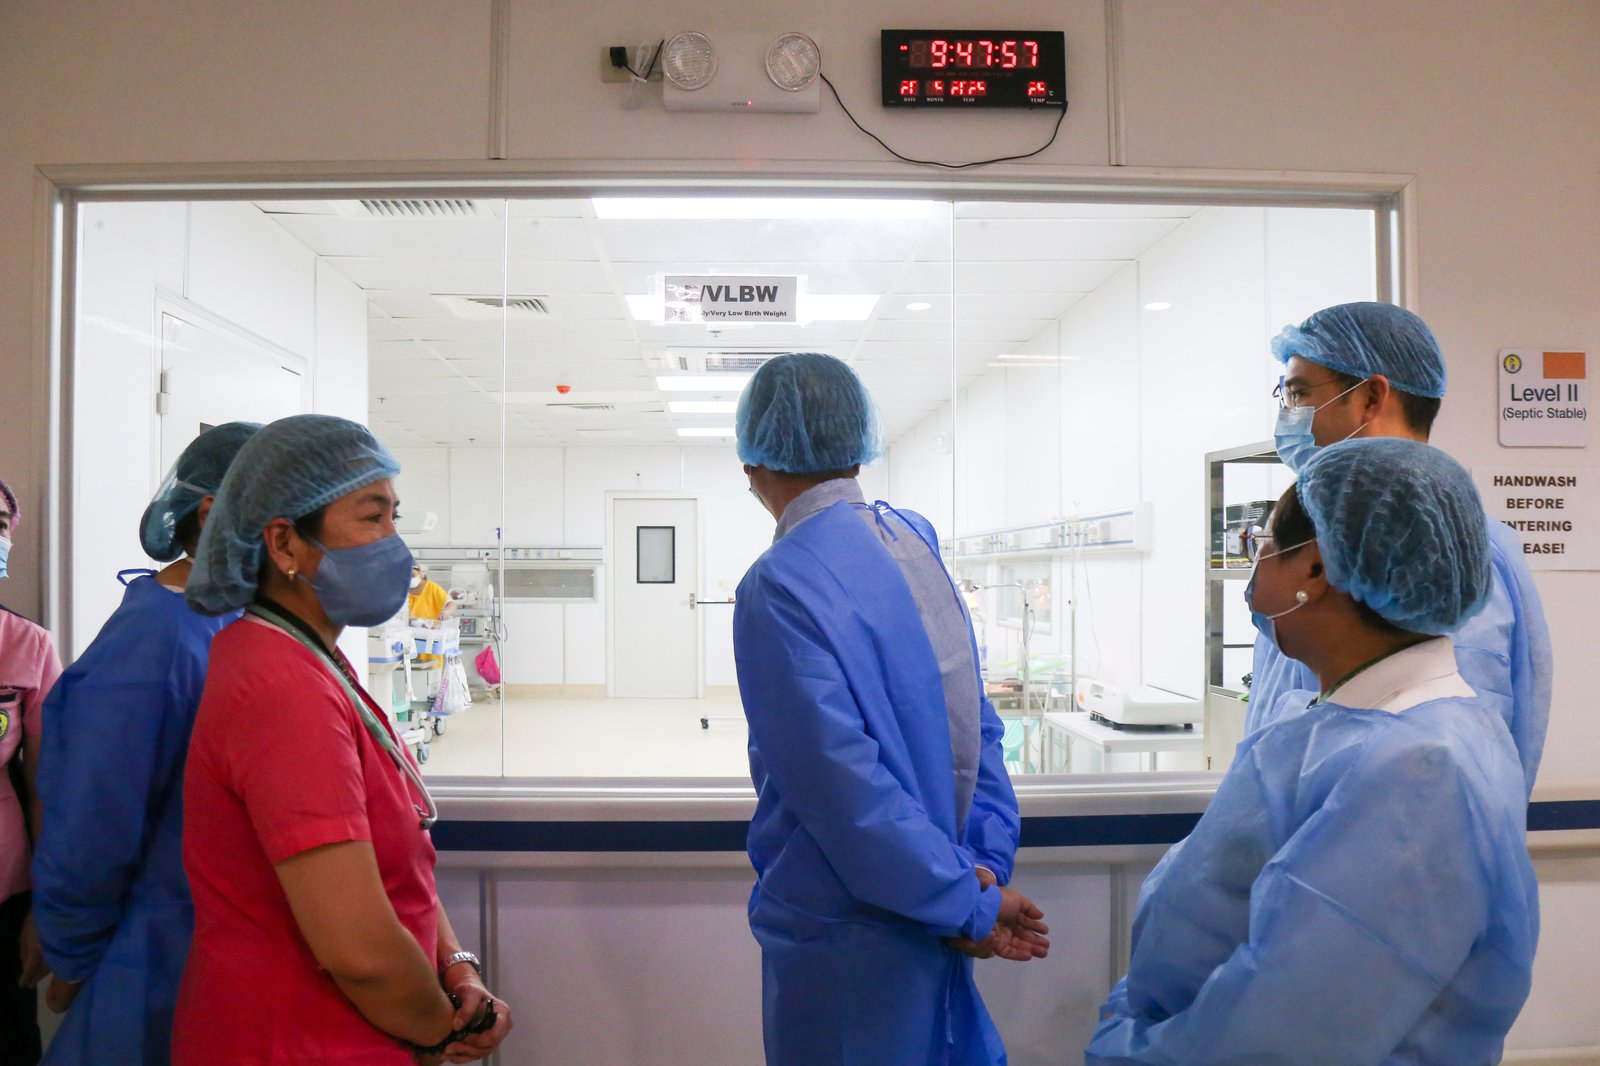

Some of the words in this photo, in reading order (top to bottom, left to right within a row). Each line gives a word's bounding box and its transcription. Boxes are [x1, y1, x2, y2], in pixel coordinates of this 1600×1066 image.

[931, 40, 1039, 68] 9:47:57
[763, 310, 787, 318] Weight
[1511, 383, 1560, 402] Level
[1568, 383, 1578, 402] II
[1503, 407, 1543, 421] (Septic
[1546, 407, 1587, 421] Stable)
[1493, 475, 1577, 487] HANDWASH
[1506, 498, 1564, 509] BEFORE
[1500, 520, 1572, 532] NTERING
[1523, 543, 1565, 554] EASE!
